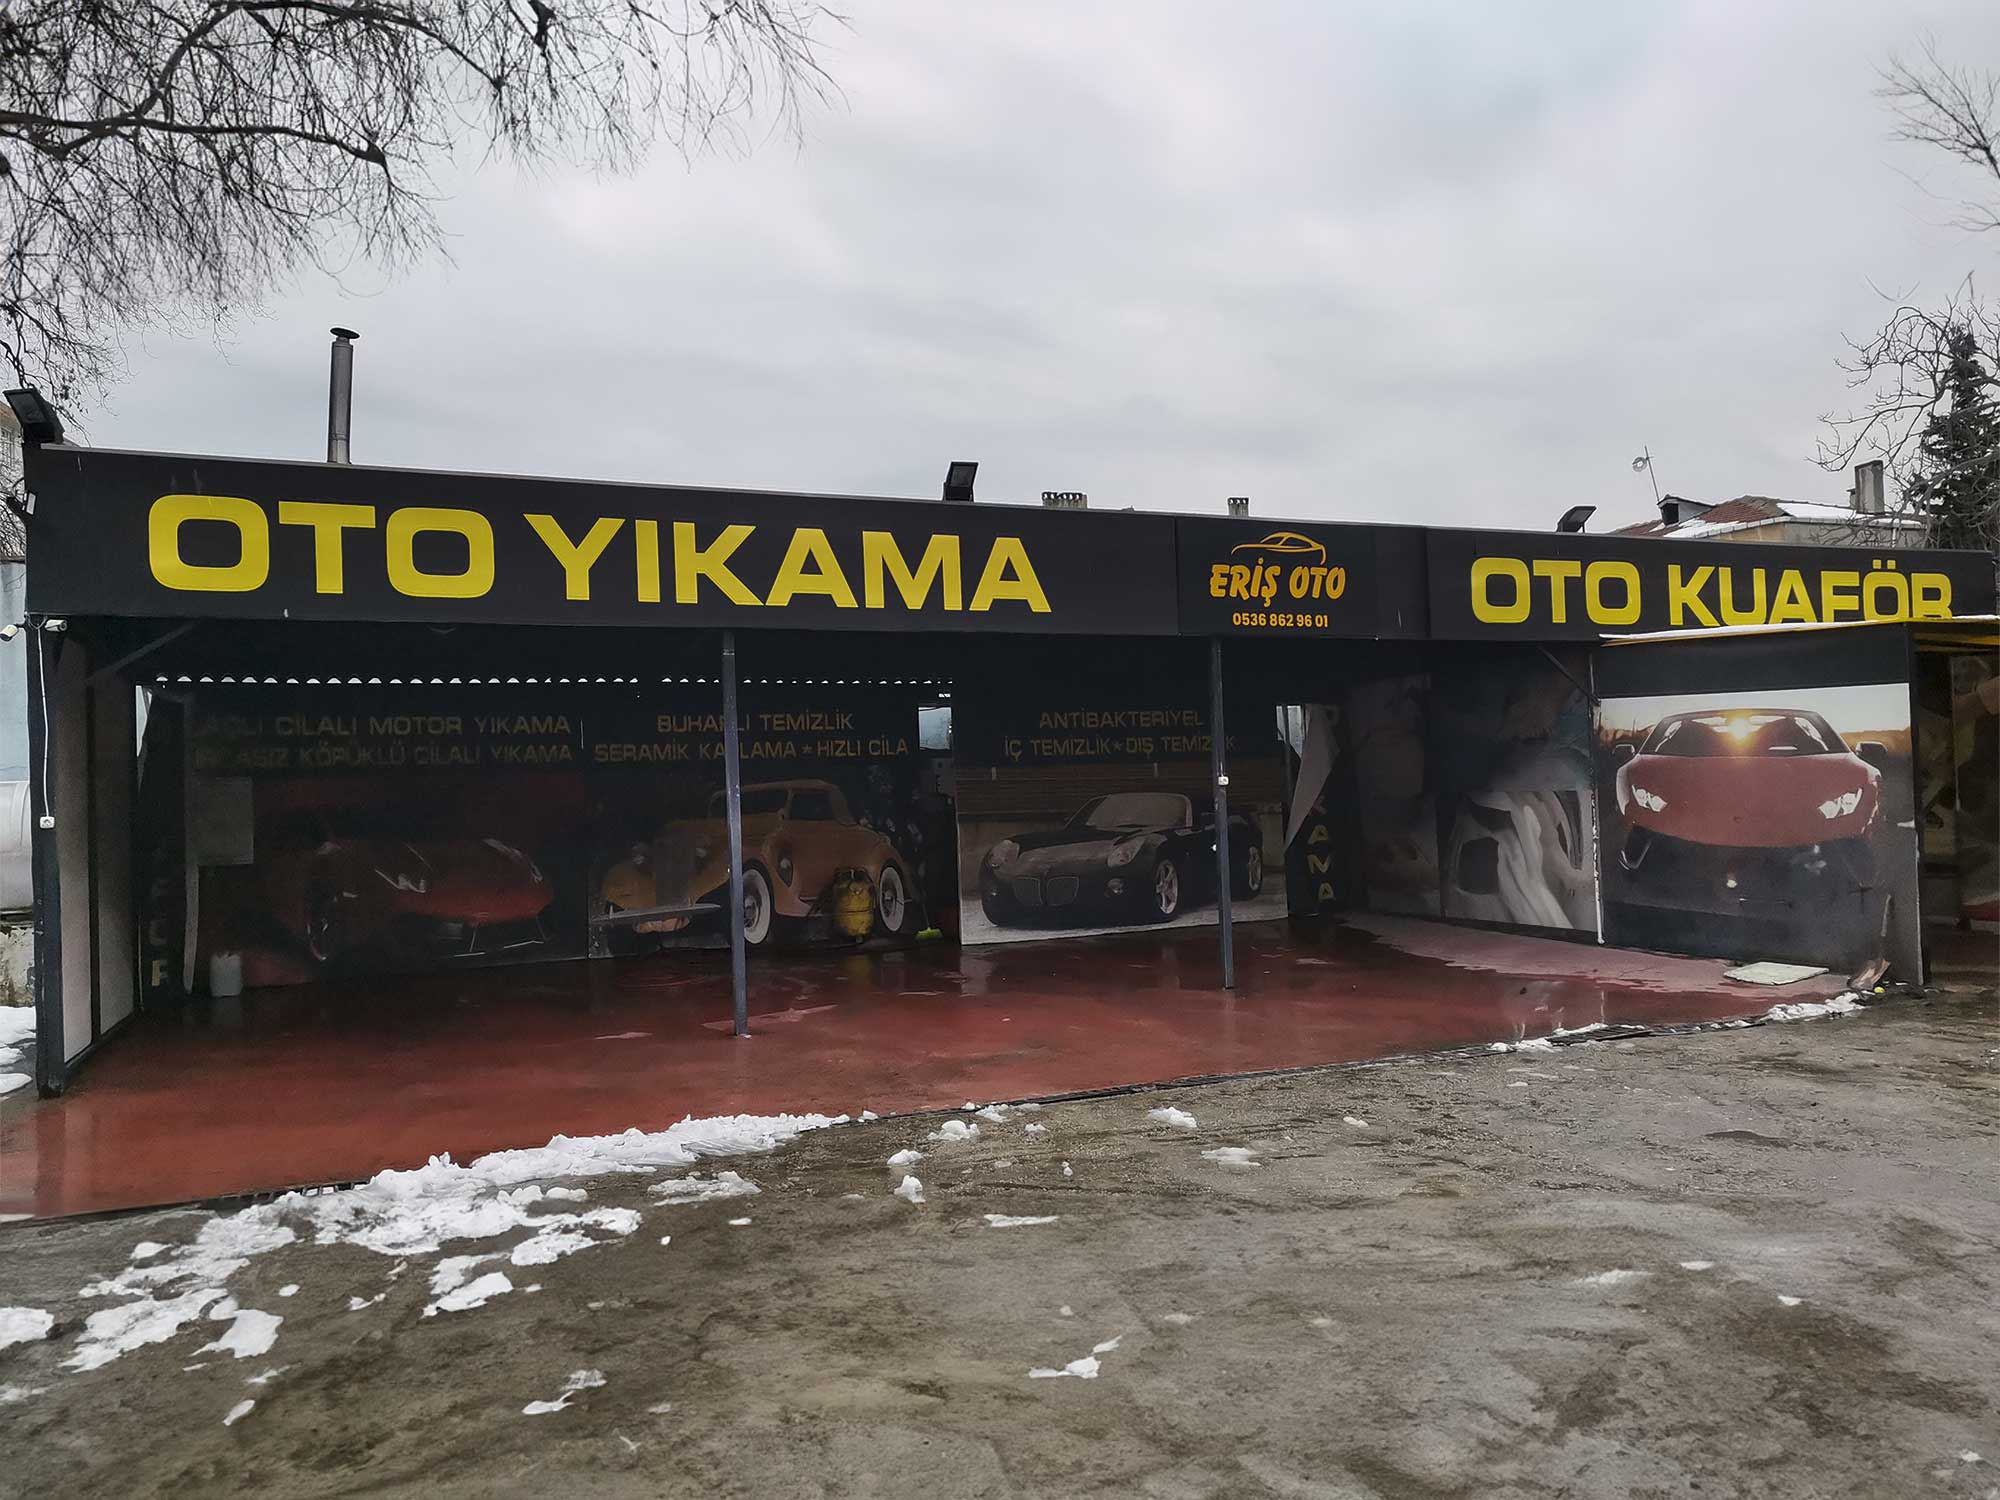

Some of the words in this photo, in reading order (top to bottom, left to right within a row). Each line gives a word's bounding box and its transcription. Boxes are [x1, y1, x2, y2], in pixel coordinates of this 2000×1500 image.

[148, 493, 495, 599] OTO
[523, 513, 1052, 615] YIKAMA
[1209, 558, 1281, 608] ERİŞ
[1289, 565, 1346, 600] OTO
[1470, 557, 1641, 626] OTO
[1668, 560, 1953, 627] KUAFÖR
[1232, 612, 1267, 627] 0536
[1269, 613, 1294, 628] 862
[1296, 614, 1313, 628] 96
[1315, 614, 1329, 629] 01
[368, 716, 464, 736] MOTOR
[474, 715, 571, 736] YIKAMA
[655, 714, 750, 734] BUHAI
[759, 708, 856, 732] TEMİZLİK
[1039, 707, 1205, 729] ANTİBAKTERİYEL
[490, 743, 573, 764] YIKAMA
[593, 738, 689, 763] SERAMİK
[699, 739, 797, 761] KALAMA
[816, 737, 861, 758] HIZLI
[867, 733, 910, 757] CİLA
[1003, 735, 1023, 762] İÇ
[1030, 731, 1112, 758] TEMİZLİK
[1126, 736, 1154, 760] DIŞ
[1161, 735, 1236, 754] TEMİZK
